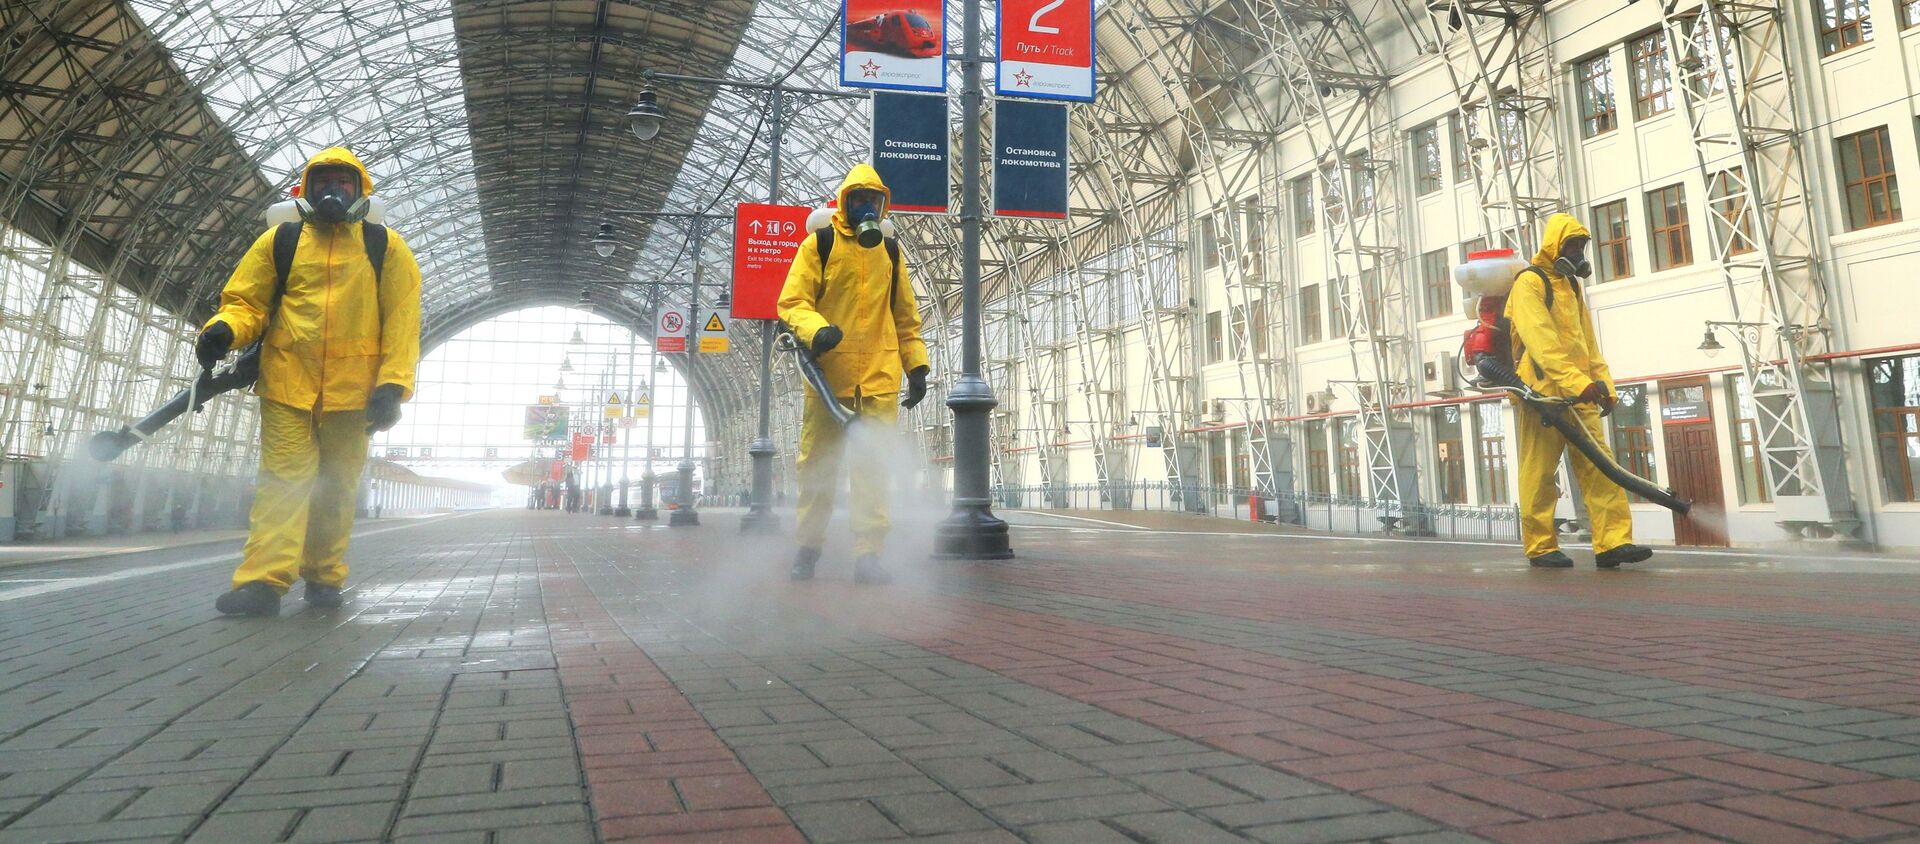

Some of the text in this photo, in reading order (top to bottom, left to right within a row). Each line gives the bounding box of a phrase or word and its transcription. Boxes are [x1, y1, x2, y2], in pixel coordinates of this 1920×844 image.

[1016, 42, 1041, 54] Путь
[1051, 45, 1074, 56] Track
[884, 139, 937, 150] Остановка
[879, 150, 942, 161] локомотива
[1005, 147, 1057, 157] Остановка
[1001, 158, 1061, 168] локомотива
[748, 238, 772, 247] Выход
